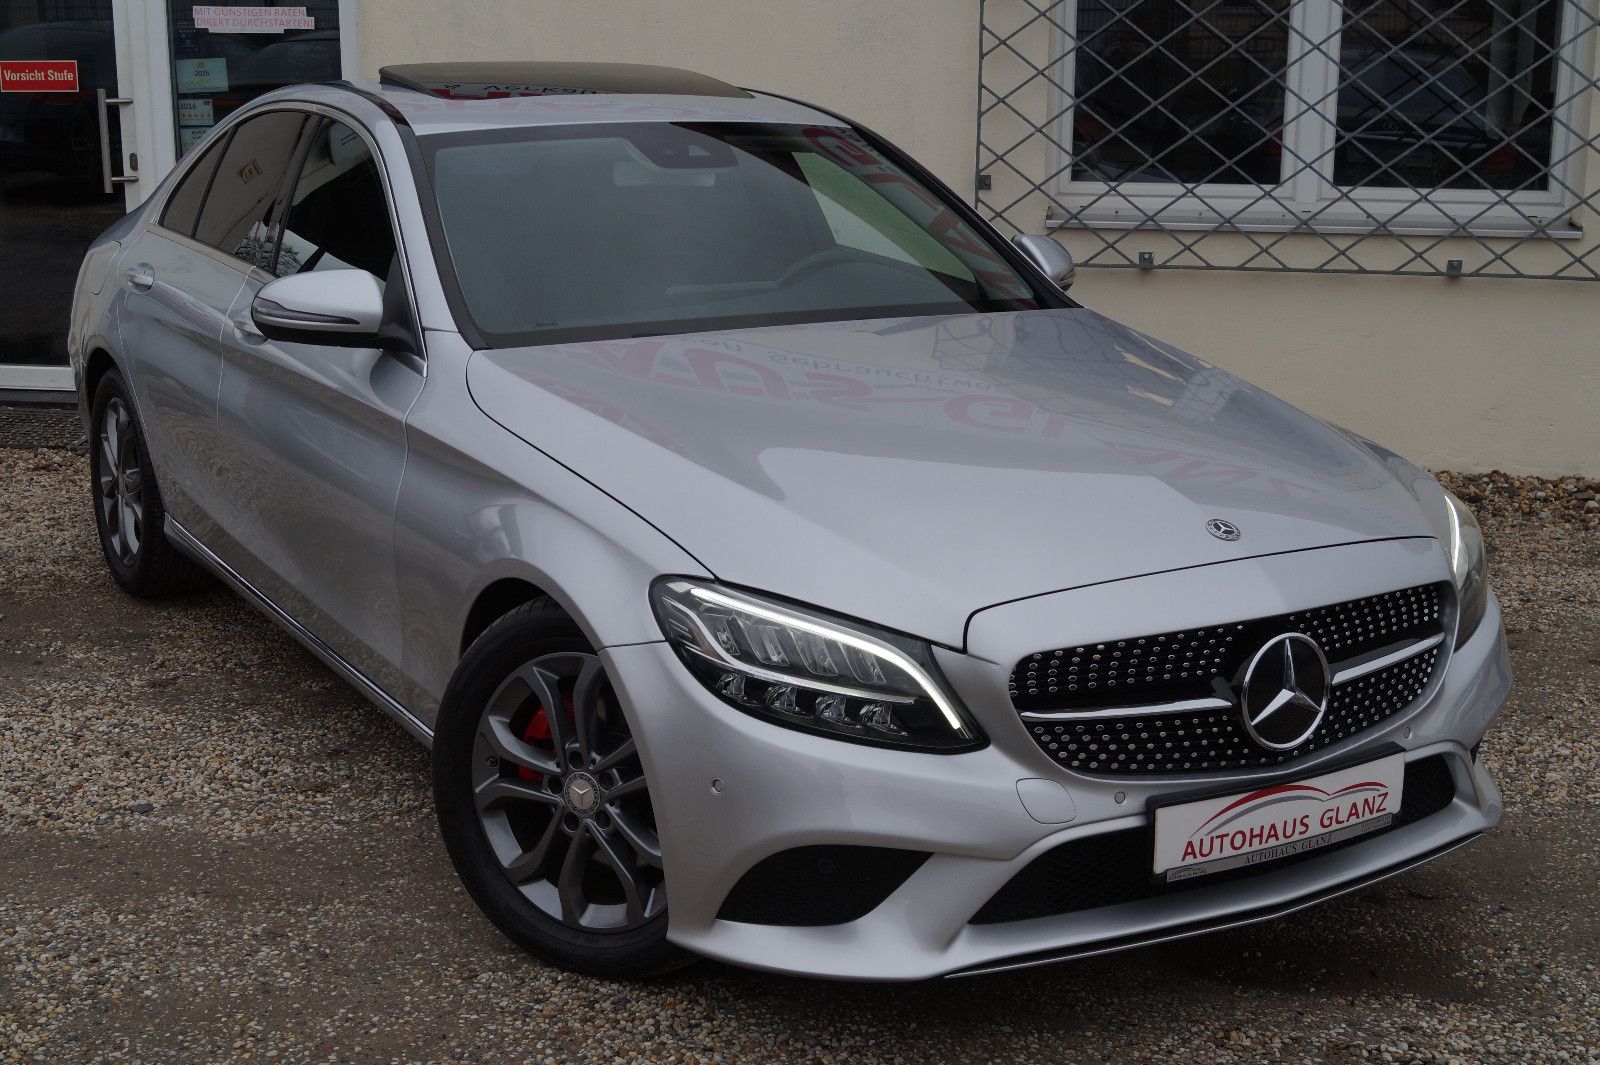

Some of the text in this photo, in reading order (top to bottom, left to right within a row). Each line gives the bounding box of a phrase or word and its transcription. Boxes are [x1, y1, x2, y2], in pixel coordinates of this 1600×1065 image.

[194, 8, 211, 17] MIT
[274, 8, 305, 17] RATEN
[196, 18, 230, 28] DIREKT
[3, 69, 74, 81] Vorsicht Stufe
[180, 102, 197, 110] 2016
[1180, 814, 1310, 862] AUTOHAUS
[1320, 791, 1389, 829] GLANZ
[1243, 833, 1333, 865] AUTOHAUS GLANZ
